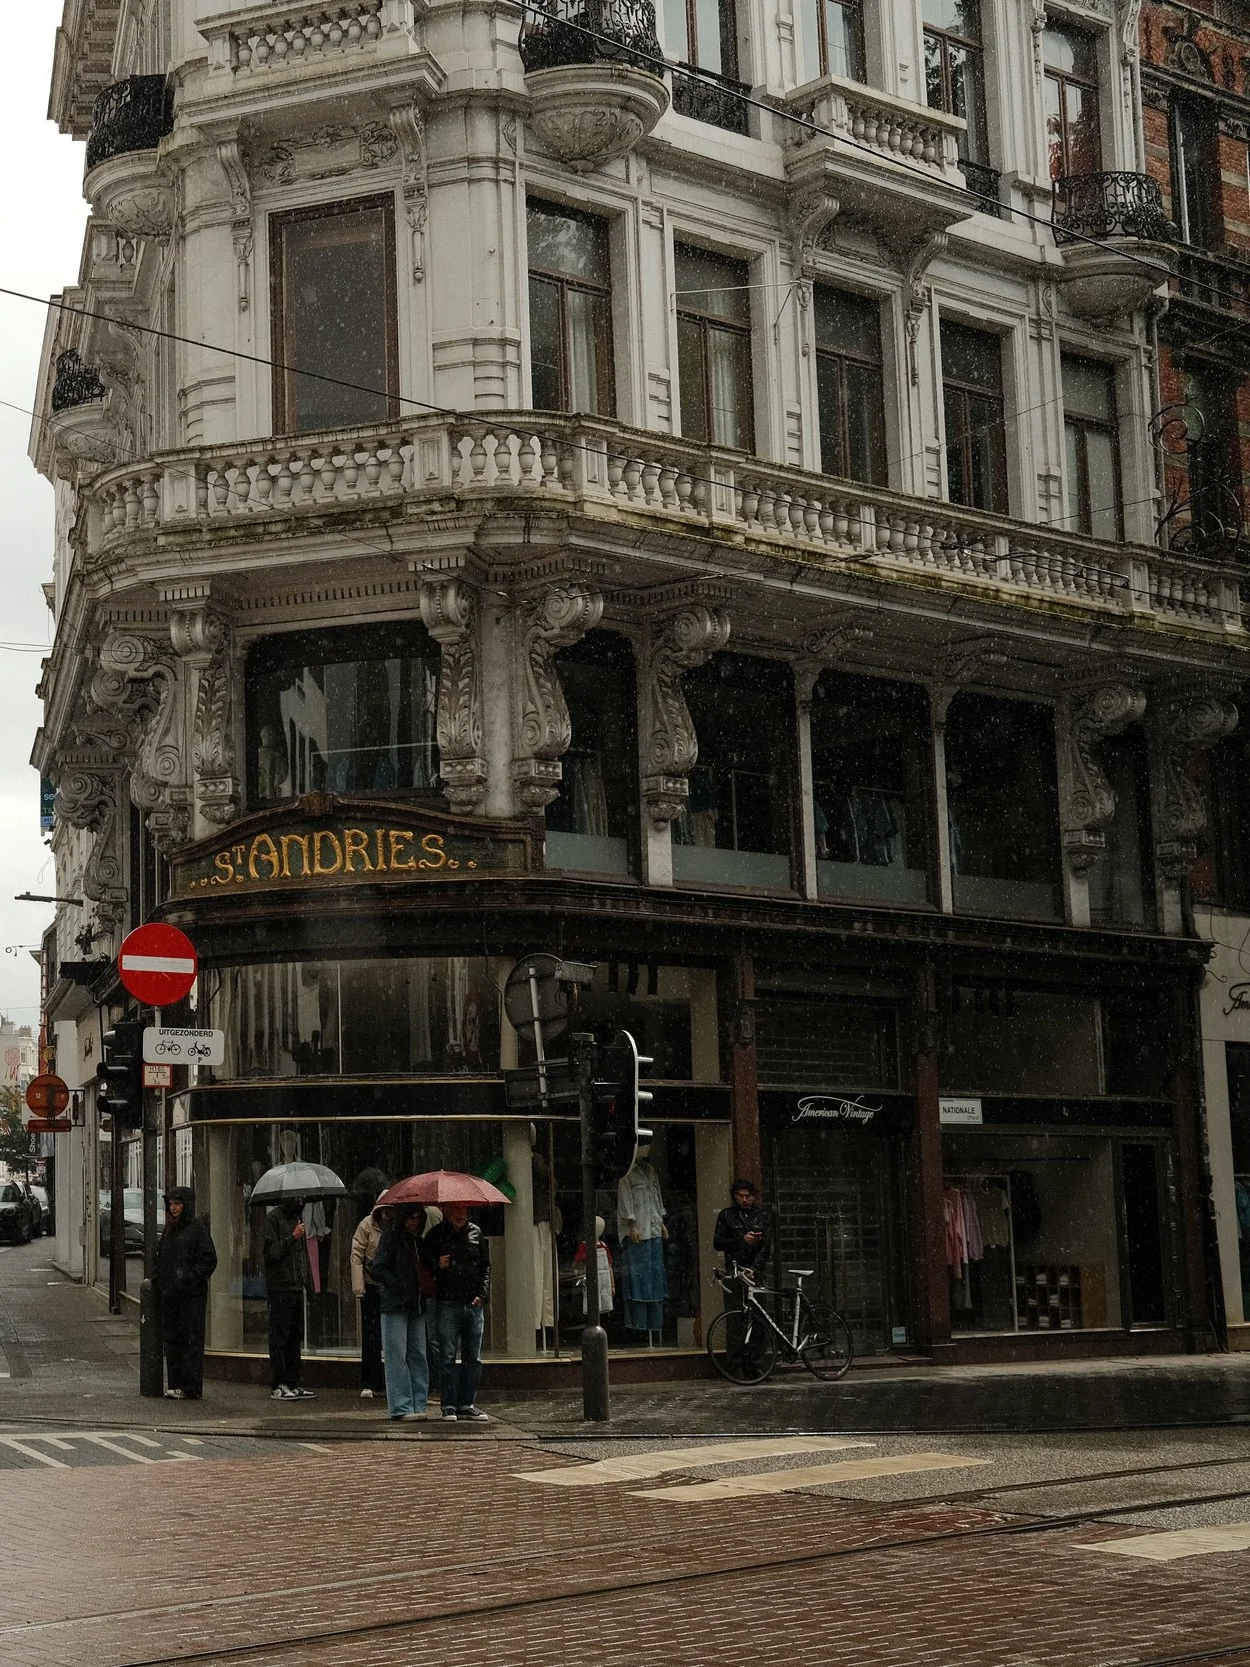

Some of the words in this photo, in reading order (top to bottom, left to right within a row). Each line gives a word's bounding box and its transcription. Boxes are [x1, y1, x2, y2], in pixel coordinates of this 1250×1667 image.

[159, 1029, 214, 1038] UITGEZONDERD
[840, 1096, 875, 1124] Vintage
[942, 1106, 975, 1114] NATIONALE
